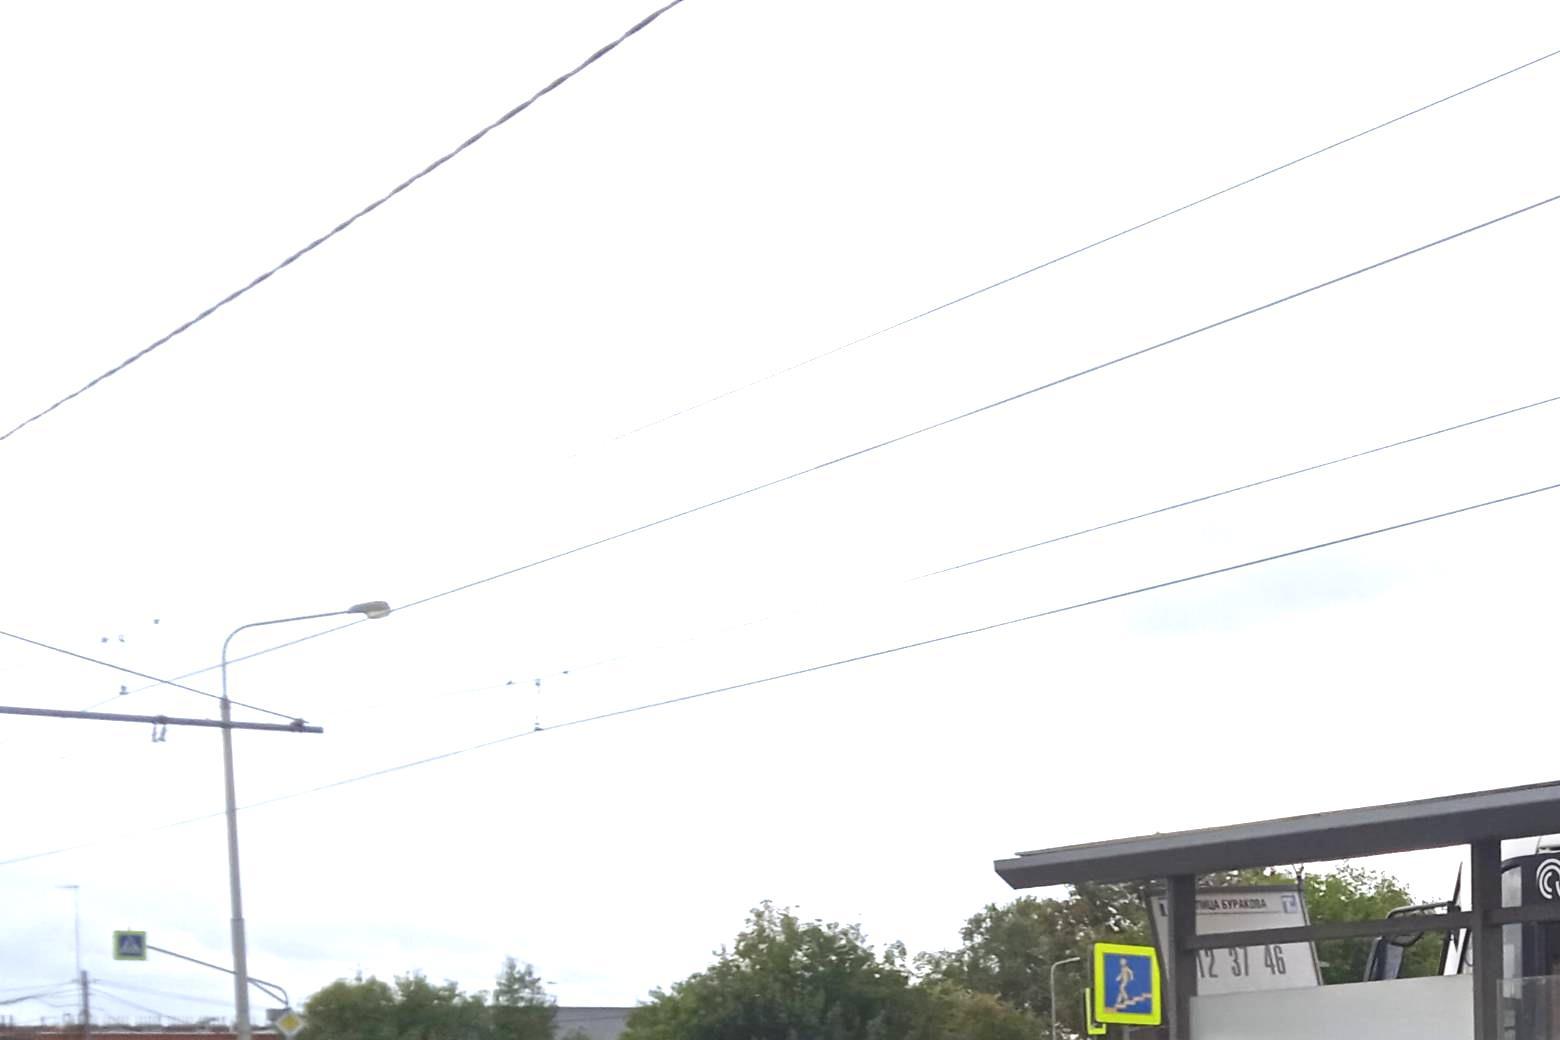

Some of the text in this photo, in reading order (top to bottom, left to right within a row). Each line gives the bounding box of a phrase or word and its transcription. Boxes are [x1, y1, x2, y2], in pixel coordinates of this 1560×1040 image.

[1196, 898, 1267, 910] ЛИЦА БУРАКОВА
[1265, 946, 1286, 975] 46
